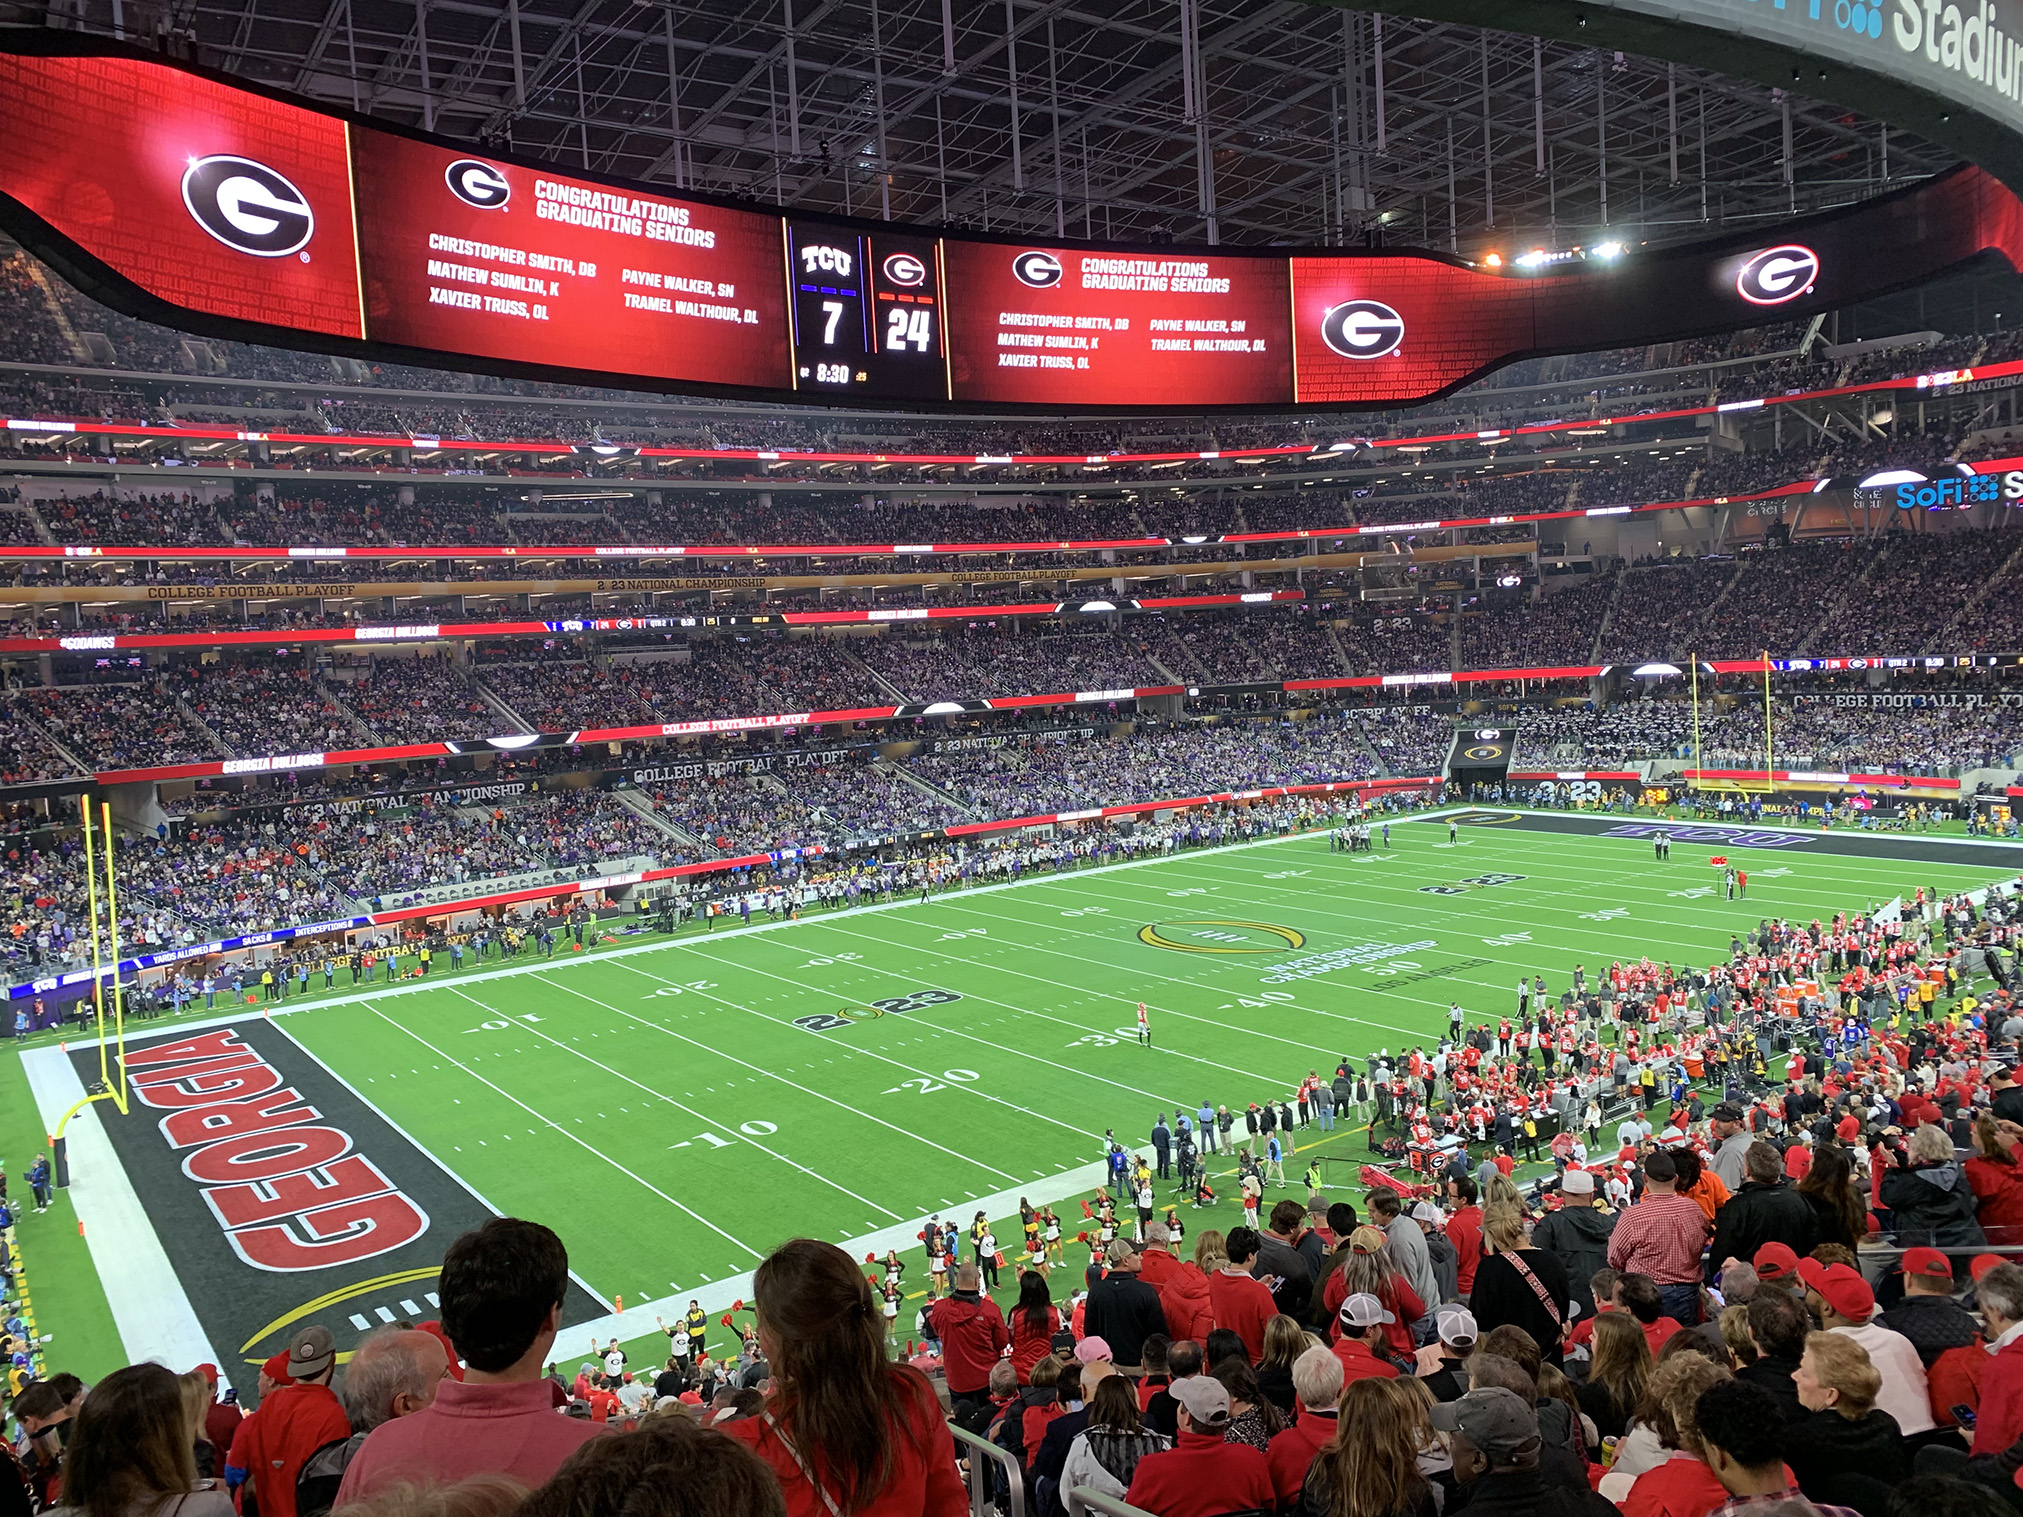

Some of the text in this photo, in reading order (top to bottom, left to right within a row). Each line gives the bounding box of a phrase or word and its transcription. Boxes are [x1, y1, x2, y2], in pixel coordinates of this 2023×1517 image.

[535, 179, 690, 226] CONGRATULATIONS
[536, 202, 715, 249] GRADUATING SENIORS
[429, 233, 597, 277] CHRISTOPHER SMITH, DB
[802, 246, 851, 276] TCU
[427, 260, 559, 297] MATHEW SUMLIN, K
[1081, 258, 1208, 277] CONGRATULATIONS
[622, 269, 734, 298] PAYNE WALKER, SN
[1082, 273, 1230, 293] GRADUATING SENIORS
[429, 287, 549, 320] XAVIER TRUSS, OL
[624, 293, 759, 324] TRAMEL WALTHOUR, DL
[823, 301, 930, 352] 7 24
[999, 312, 1129, 331] CHRISTOPHER SMITH, DB
[1150, 319, 1245, 333] PAYNE WALKER, SN
[998, 333, 1099, 350] MATHEW SUMLIN, K
[1151, 338, 1266, 352] TRAMEL WALTHOUR, DL
[817, 363, 849, 383] 8:30
[998, 354, 1090, 370] XAVIER TRUSS, OL
[1897, 478, 1961, 508] SoFi
[627, 579, 683, 591] NATIONAL
[685, 578, 765, 589] CHAMPIONSHIP
[951, 569, 1077, 582] COLLEGE FOOTBALL PLAYOFF
[148, 585, 355, 599] COLLEGE FOOTBALL PLAYOFF
[1926, 658, 1943, 666] 8:30
[662, 714, 809, 735] COLLEGE FOOTBALL PLAYOFF
[222, 753, 324, 774] GEORGIA BULLDOGS
[1599, 824, 1817, 847] TCU
[153, 953, 176, 964] YARDS
[178, 946, 208, 960] ALLOWED
[243, 934, 265, 946] SACKS
[295, 922, 347, 937] INTERCEPTIONS
[1258, 940, 1439, 984] CHAMPIONSHIP
[1261, 943, 1393, 972] NATIONAL
[1361, 961, 1422, 976] 50
[1363, 958, 1494, 993] LOS ANGELES
[1236, 991, 1296, 1009] 40
[1080, 1027, 1149, 1047] 30
[1470, 1052, 1476, 1060] 7
[901, 1069, 980, 1094] 20
[692, 1120, 778, 1149] 10
[114, 1028, 430, 1272] GEORGIA
